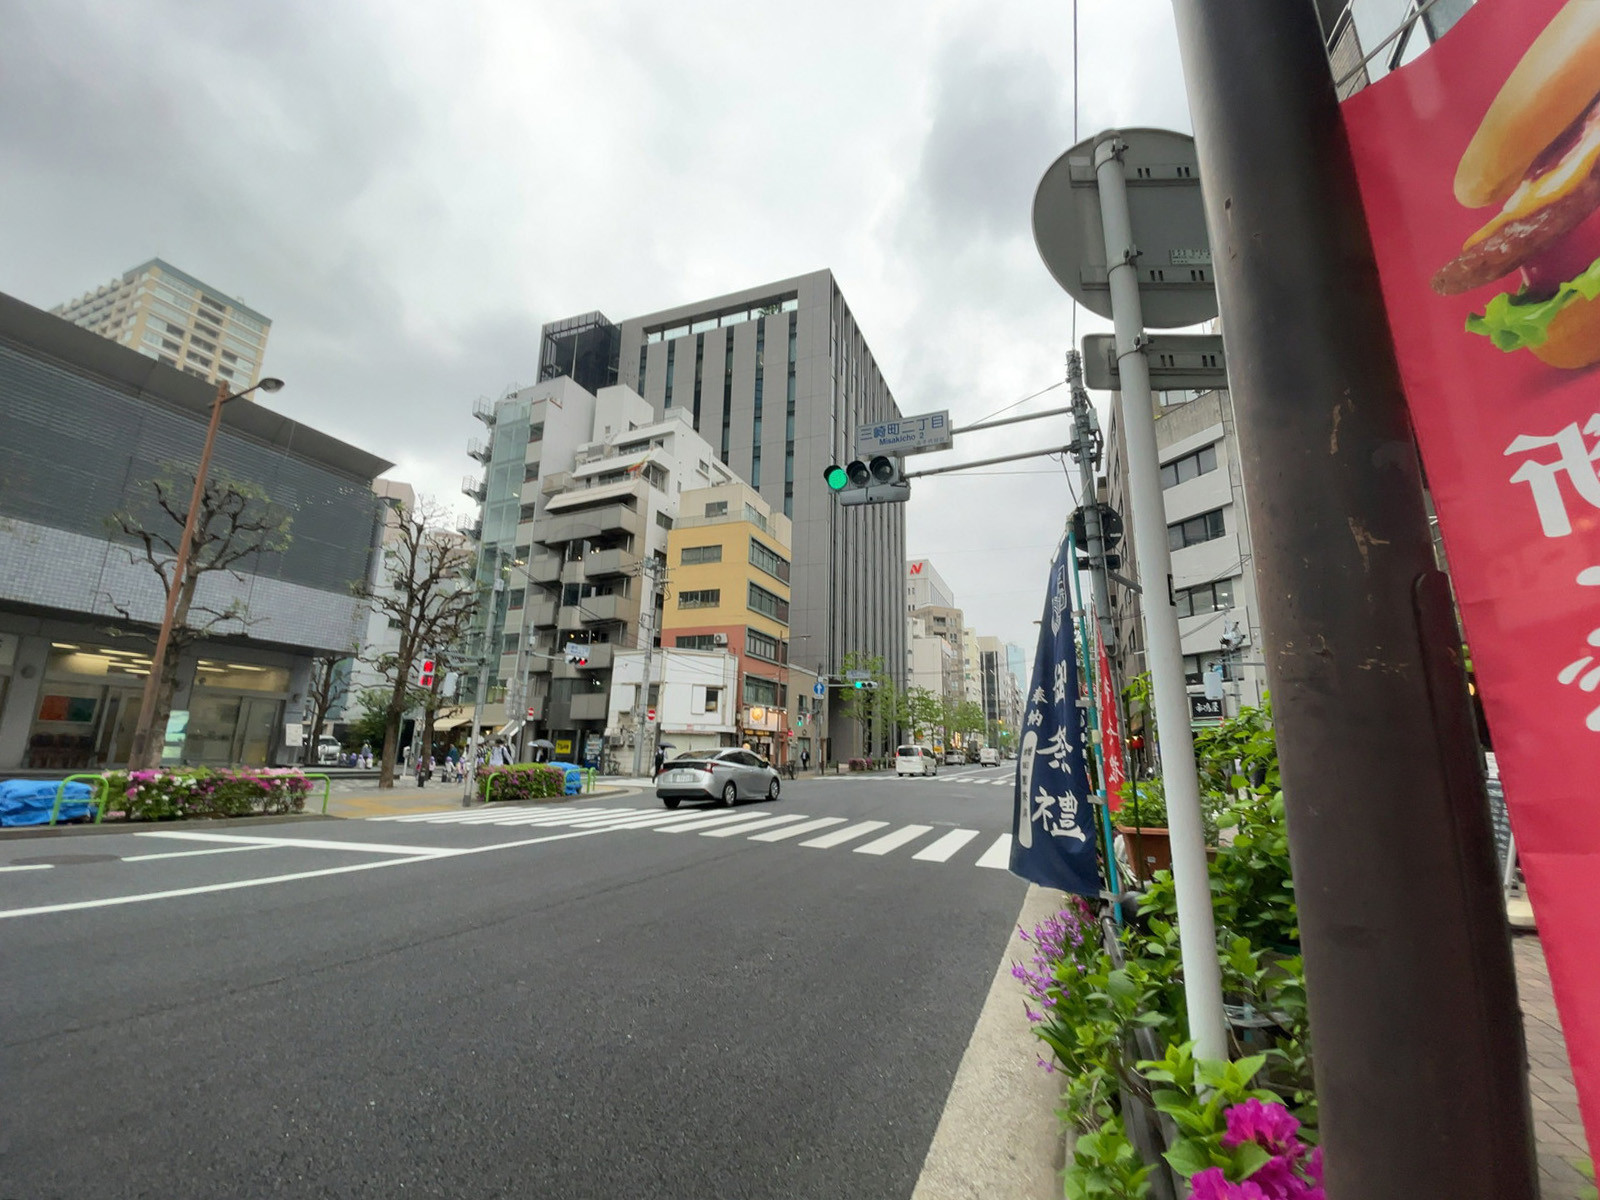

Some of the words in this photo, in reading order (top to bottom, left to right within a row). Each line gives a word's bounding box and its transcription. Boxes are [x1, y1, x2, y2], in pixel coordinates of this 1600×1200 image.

[861, 416, 943, 440] 三崎町二丁目
[880, 435, 915, 445] Misakicho
[919, 431, 924, 439] 2
